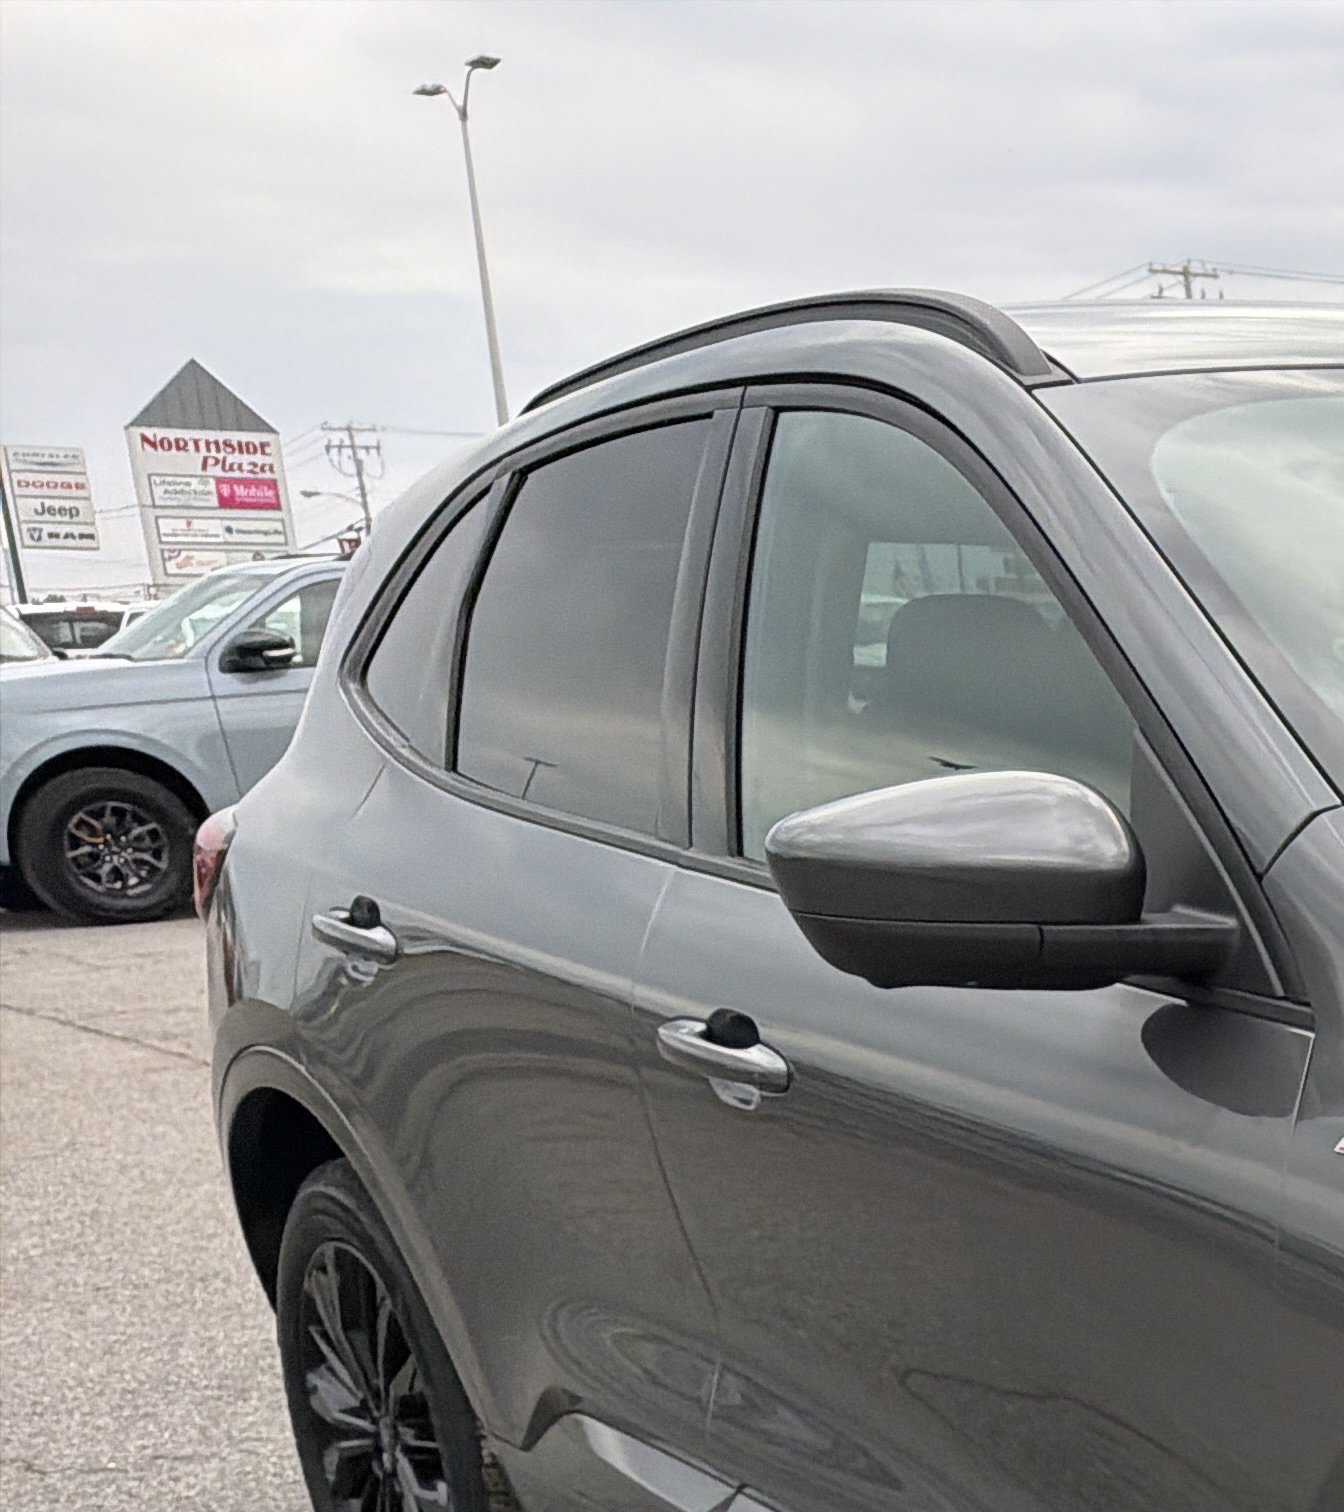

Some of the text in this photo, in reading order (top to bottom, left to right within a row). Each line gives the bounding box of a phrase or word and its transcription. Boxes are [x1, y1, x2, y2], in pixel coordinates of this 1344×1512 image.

[138, 432, 272, 456] NORTHSIDE
[200, 455, 275, 475] Plaza
[33, 501, 81, 520] Jeep
